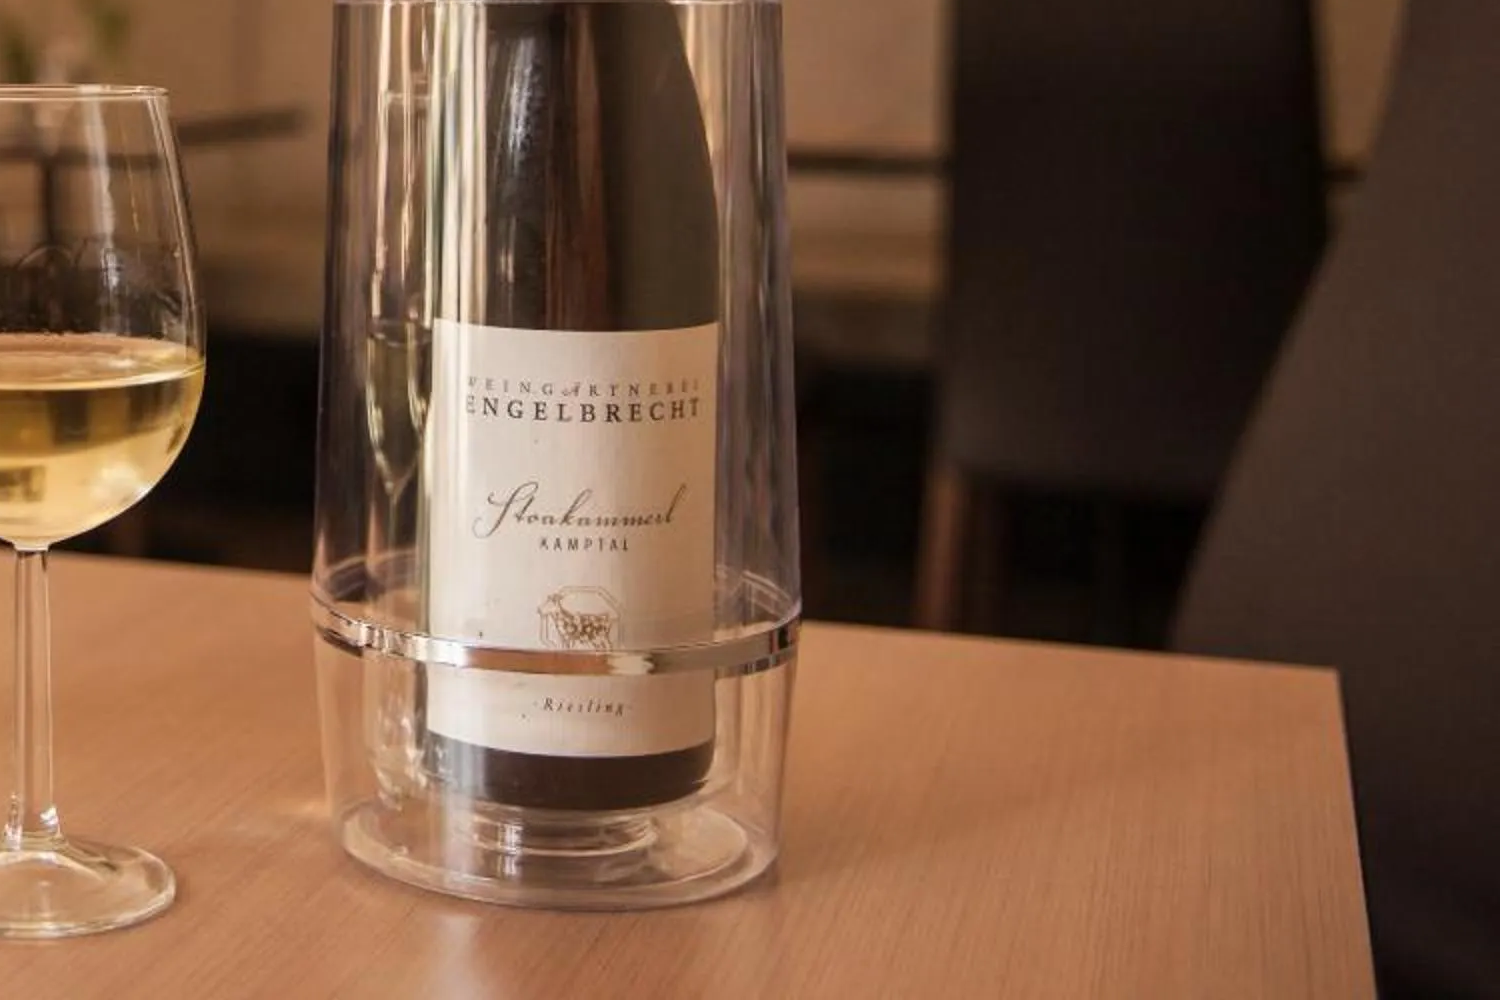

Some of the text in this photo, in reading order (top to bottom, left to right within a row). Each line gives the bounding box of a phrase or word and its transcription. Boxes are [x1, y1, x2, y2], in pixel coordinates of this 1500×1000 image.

[466, 395, 699, 424] ENGELBRECHT
[539, 537, 629, 552] KAMPTAL
[543, 697, 625, 717] Riesling
